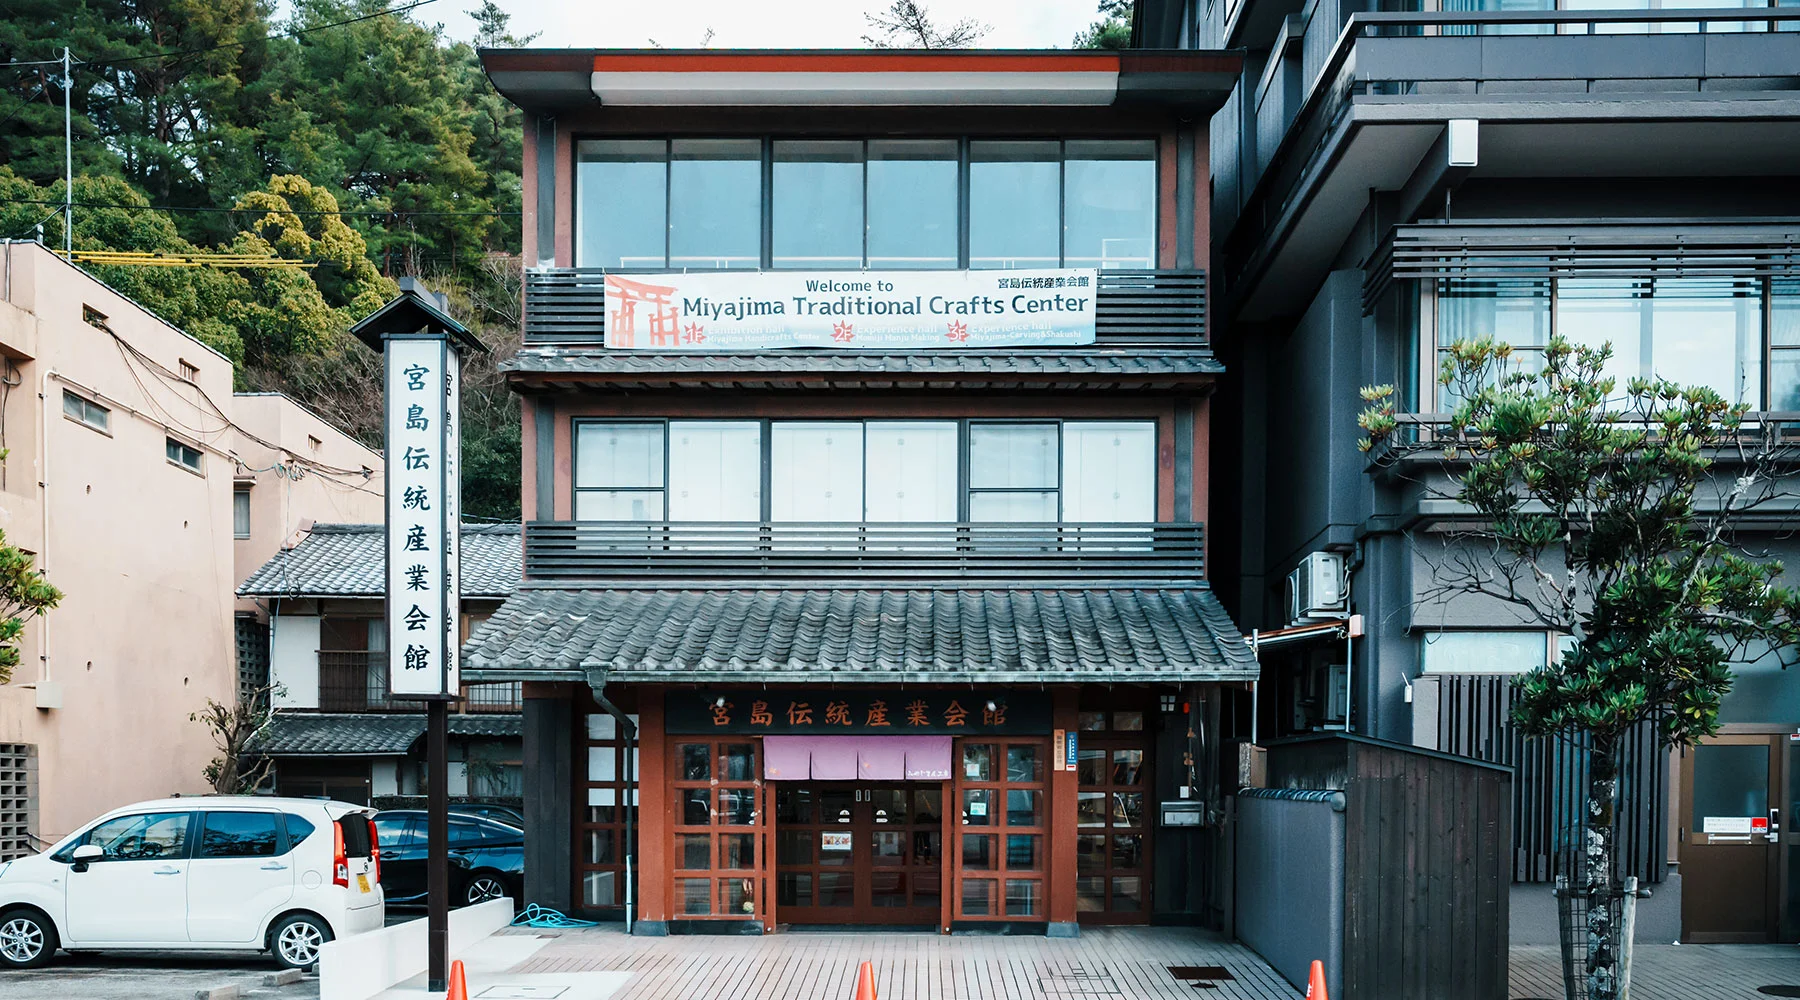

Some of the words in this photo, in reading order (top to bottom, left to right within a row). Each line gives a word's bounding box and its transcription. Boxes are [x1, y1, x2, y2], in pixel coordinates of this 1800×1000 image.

[805, 279, 872, 293] Welcome
[877, 280, 894, 292] to
[997, 276, 1090, 289] 宮島伝統産業会館
[683, 297, 785, 321] Miyajima
[792, 296, 922, 316] Traditional
[929, 295, 1005, 315] Crafts
[1011, 294, 1089, 314] Center
[1031, 320, 1052, 330] hall
[686, 328, 702, 341] 1F
[793, 332, 820, 340] Center
[835, 326, 851, 340] 2F
[911, 333, 940, 342] Making
[949, 326, 966, 340] 3F
[402, 363, 431, 671] 宮島伝統産業会館
[709, 700, 1009, 726] 宮島伝統産業会館
